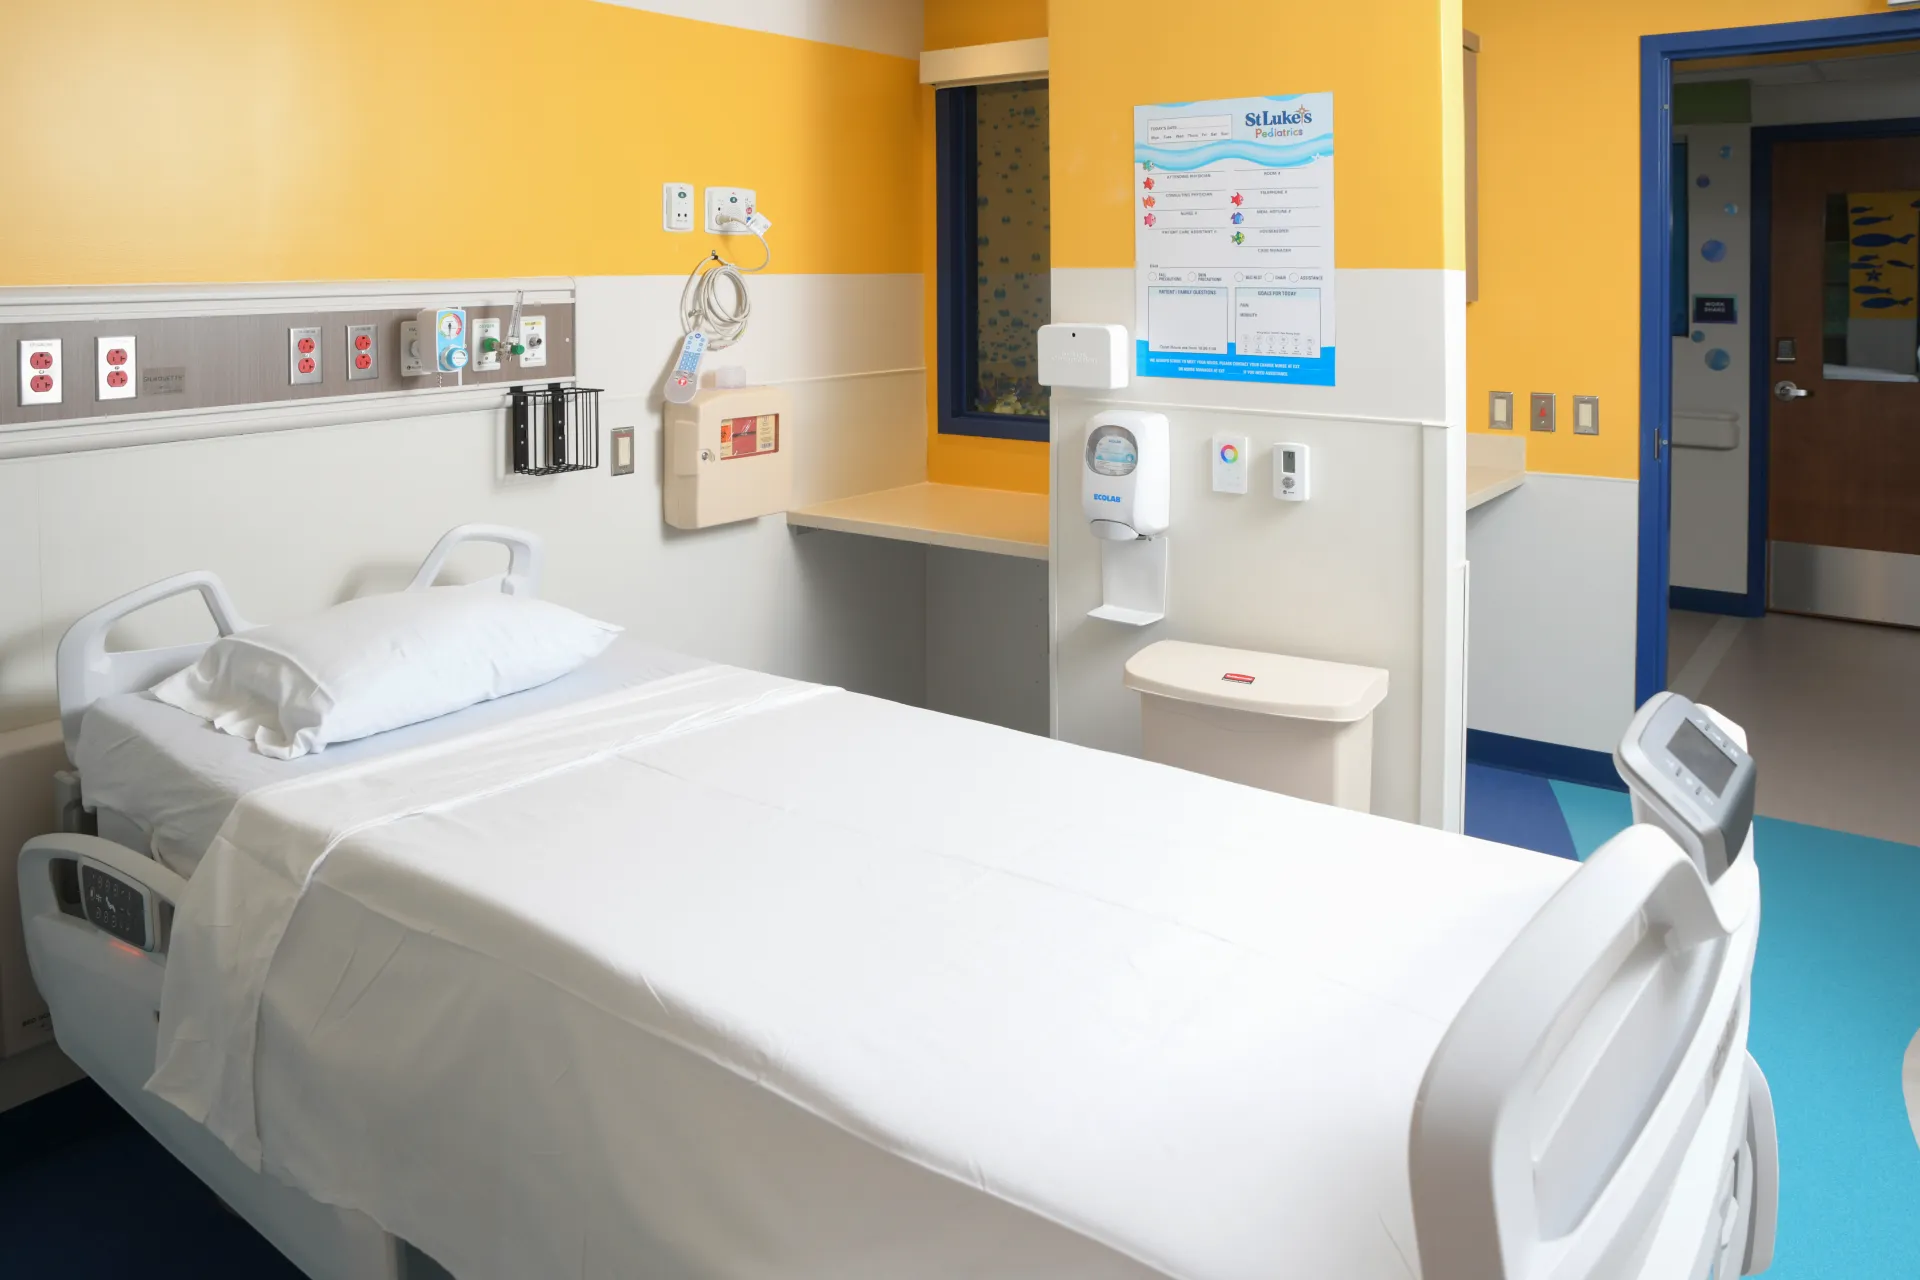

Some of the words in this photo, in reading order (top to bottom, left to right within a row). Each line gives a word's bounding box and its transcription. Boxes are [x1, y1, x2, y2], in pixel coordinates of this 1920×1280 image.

[1245, 112, 1261, 126] St
[1262, 108, 1312, 126] Luke's
[1255, 128, 1303, 138] Pediatrics
[1094, 494, 1120, 502] ECOLAB
